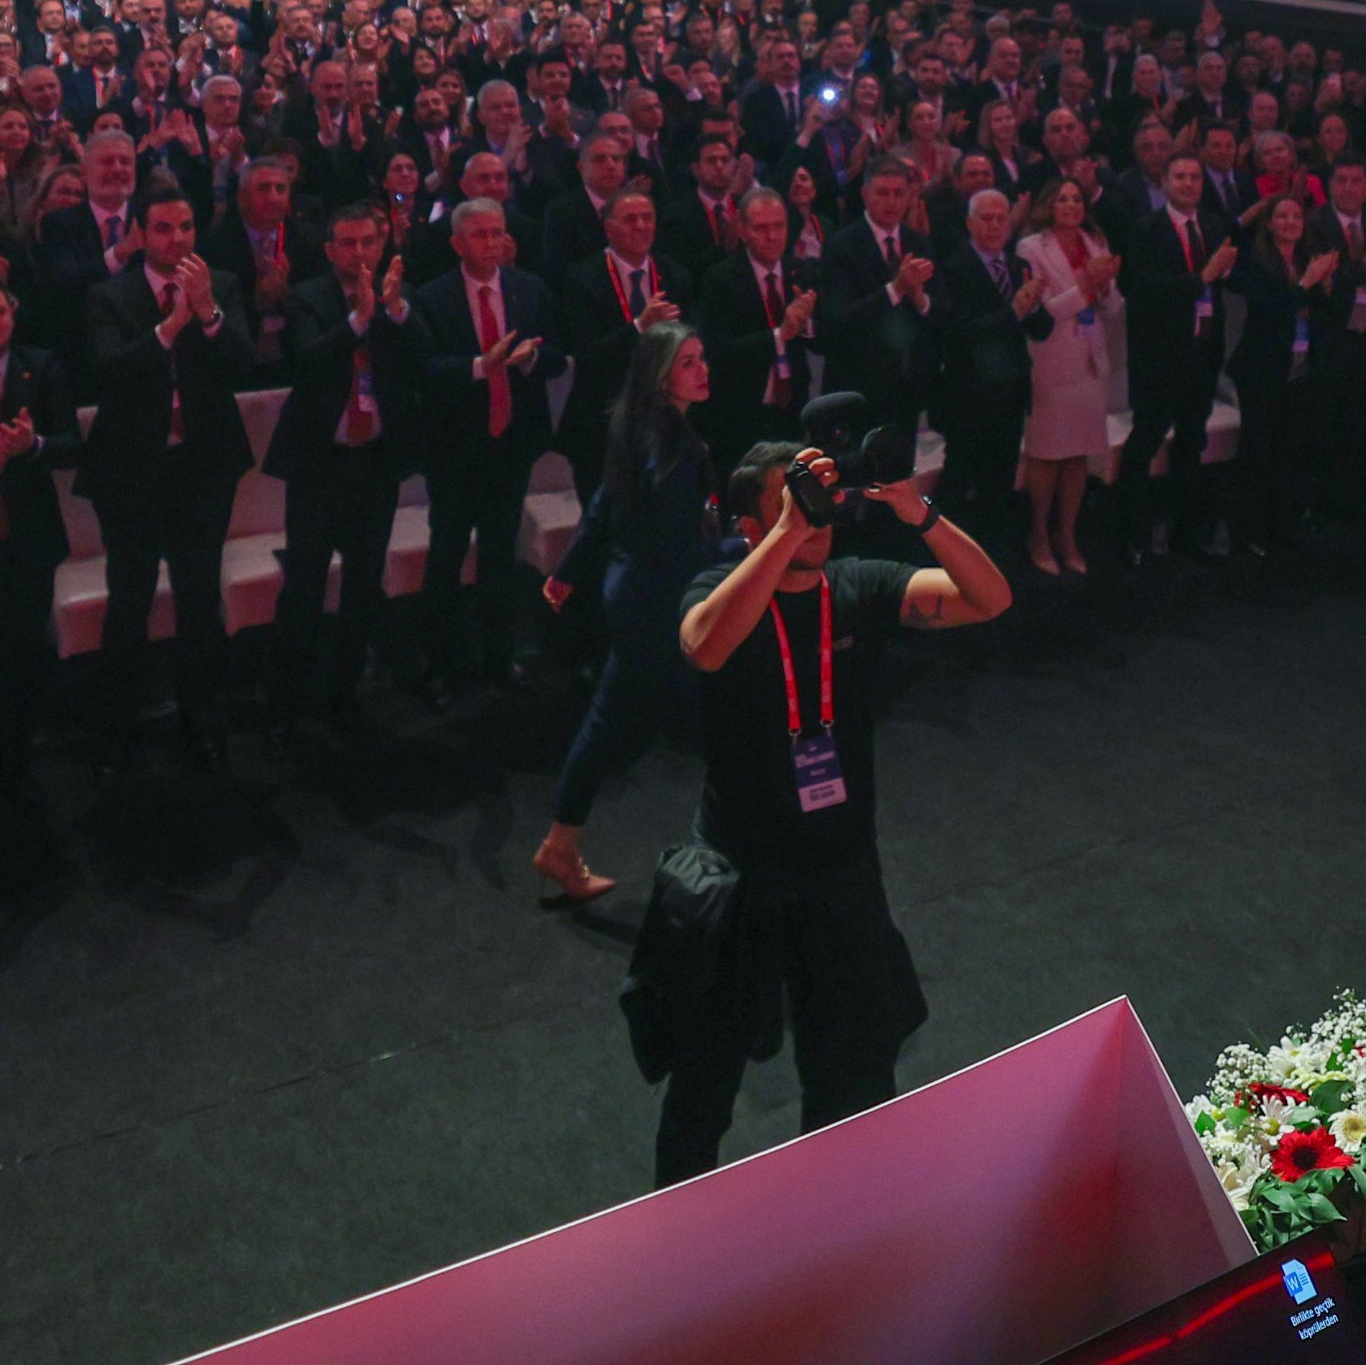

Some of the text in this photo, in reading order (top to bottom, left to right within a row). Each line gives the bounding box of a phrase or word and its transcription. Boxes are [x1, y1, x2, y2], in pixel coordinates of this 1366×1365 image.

[1290, 1297, 1336, 1327] Birlikte geçtik
[1299, 1314, 1339, 1340] köprülerden
